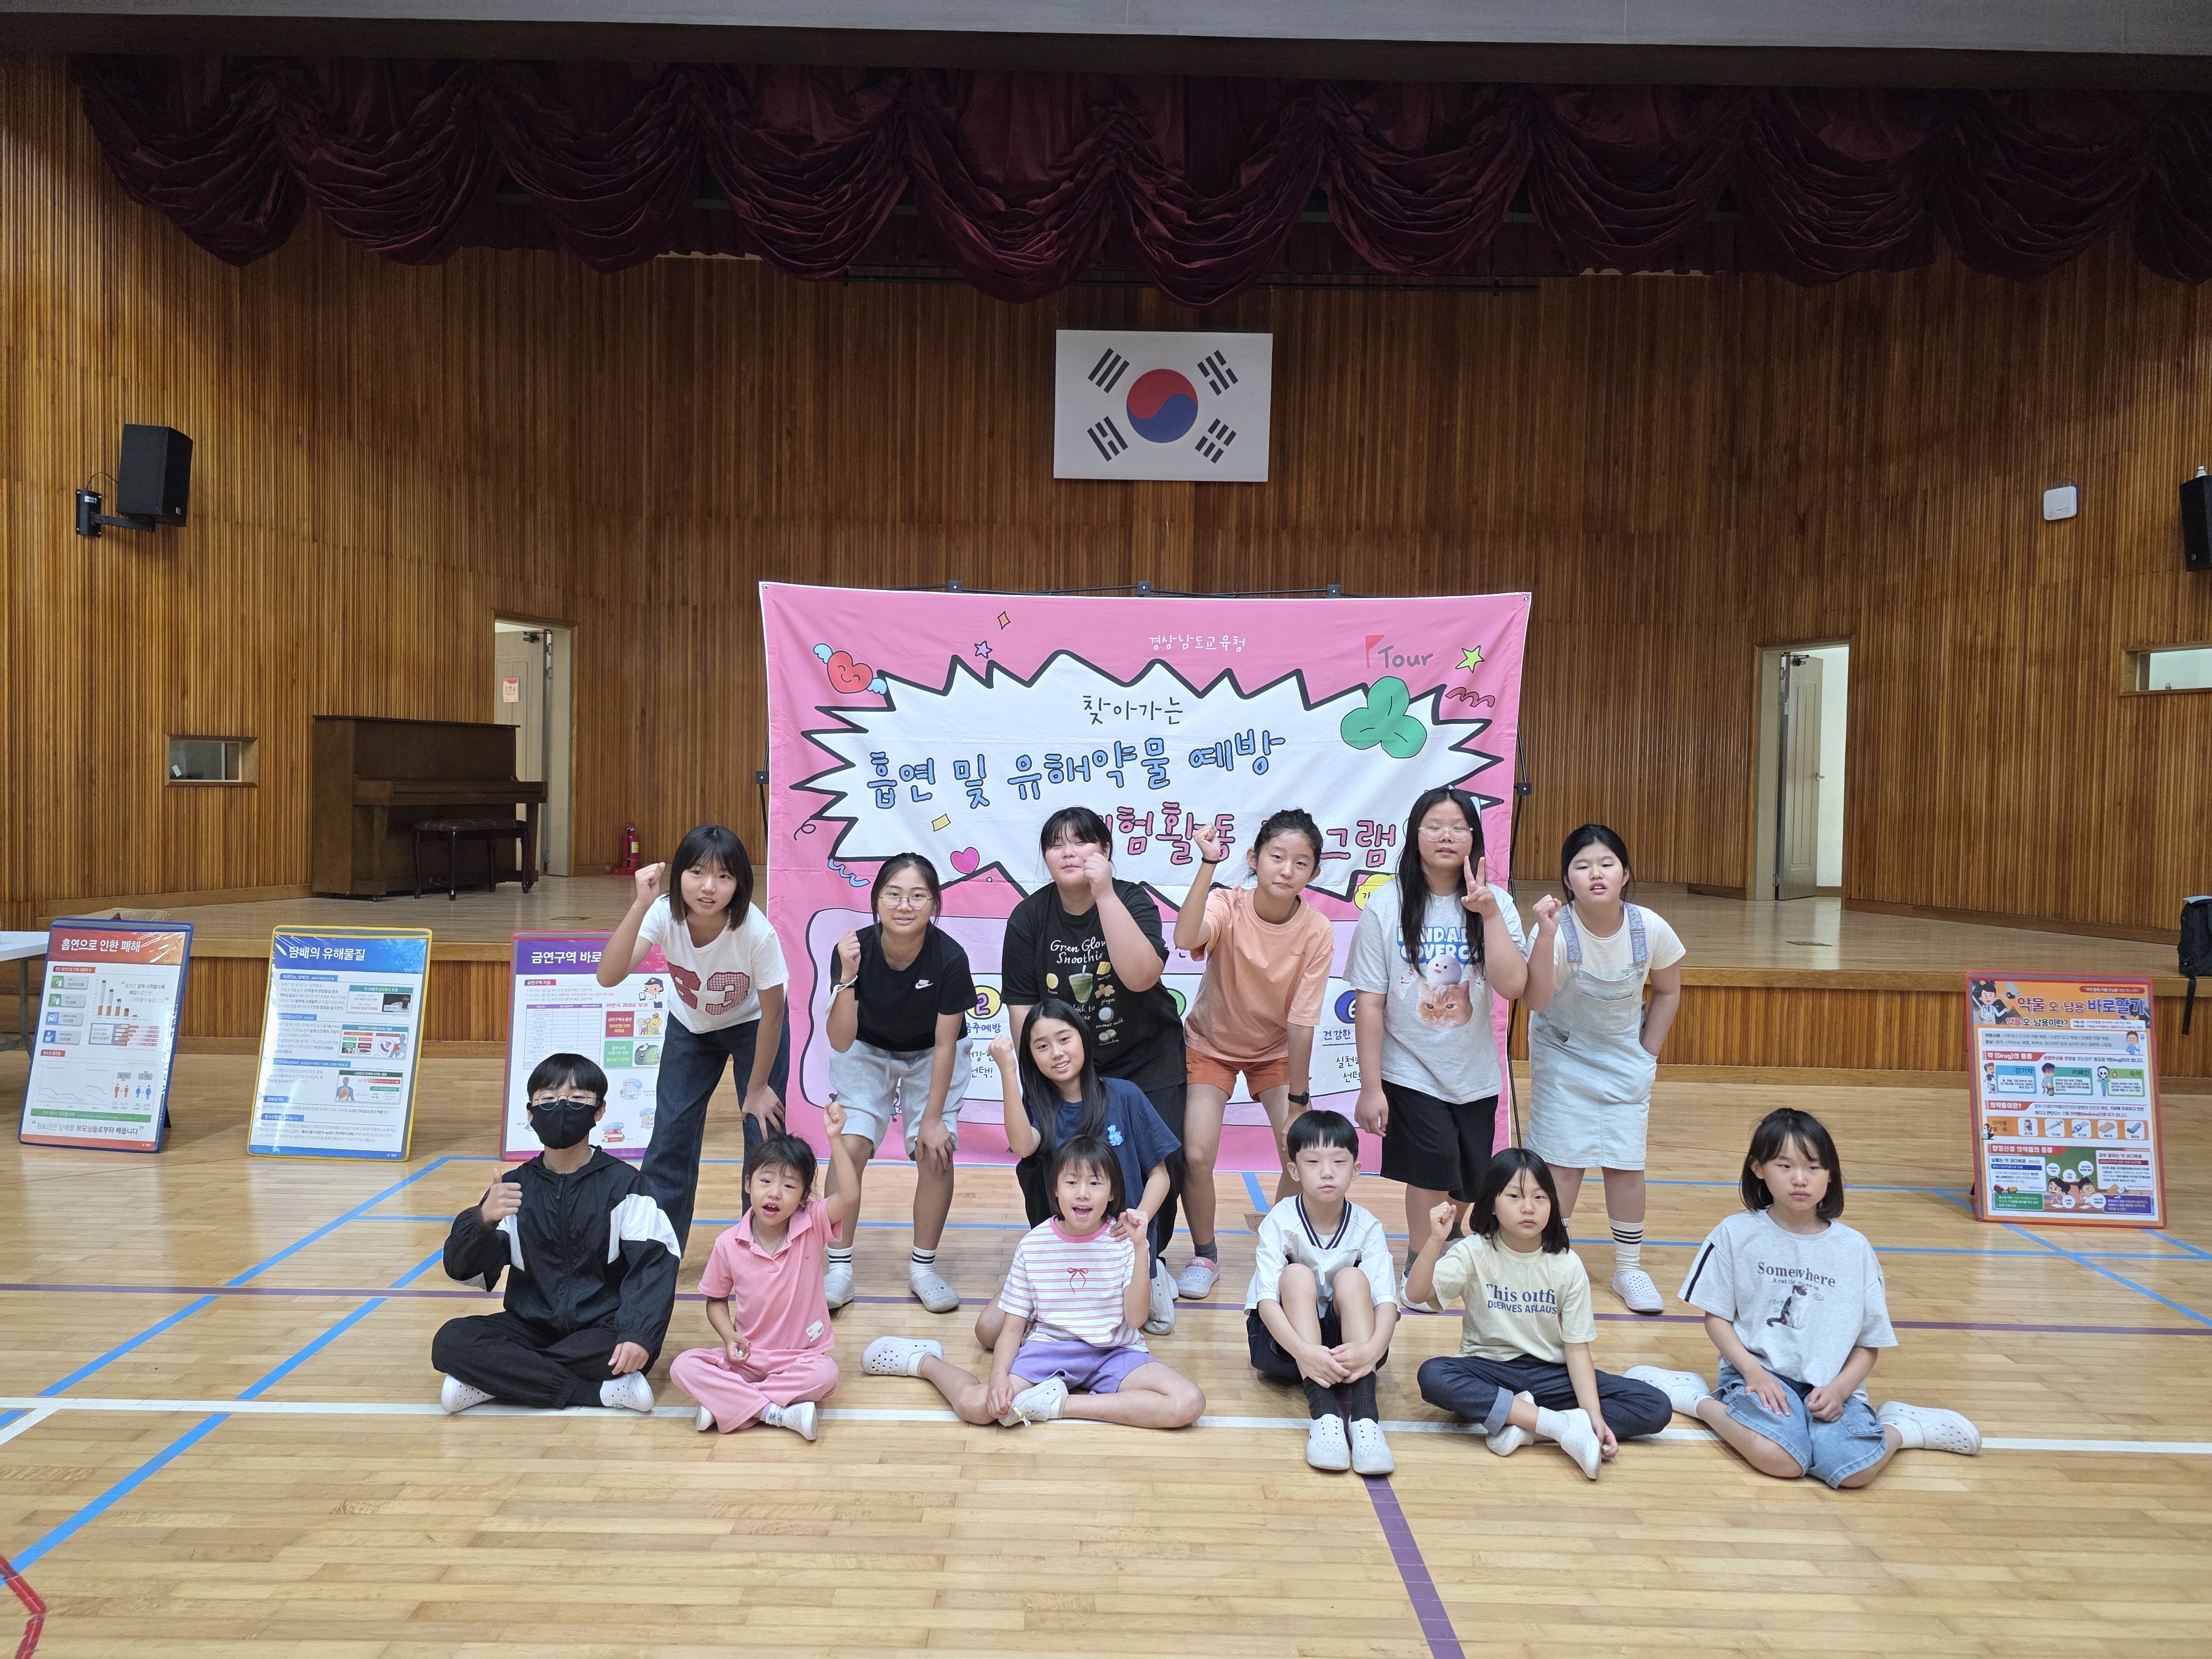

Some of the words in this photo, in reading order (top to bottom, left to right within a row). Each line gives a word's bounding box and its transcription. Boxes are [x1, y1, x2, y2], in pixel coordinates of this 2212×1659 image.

[1149, 634, 1246, 653] 경상남도교육청
[1377, 645, 1433, 667] Tour
[1083, 696, 1183, 724] 찾아가는
[867, 751, 936, 809] 흡연
[953, 754, 990, 808] 및
[1008, 737, 1171, 800] 유해약물
[1189, 729, 1286, 775] 예방
[1318, 820, 1397, 868] 그램
[61, 938, 97, 951] 흡연으로
[100, 940, 119, 952] 인한
[121, 941, 141, 952] 폐해
[289, 946, 320, 959] 담배의
[322, 948, 366, 961] 유해물질
[531, 951, 577, 964] 금연구역
[974, 993, 991, 1016] 2
[2018, 997, 2045, 1012] 약물
[2048, 1002, 2084, 1013] 오·남용
[2088, 999, 2144, 1014] 바로알기
[1323, 1030, 1351, 1041] 건강한
[76, 1125, 114, 1134] 부모님들로부터
[1757, 1261, 1835, 1287] Somewhere
